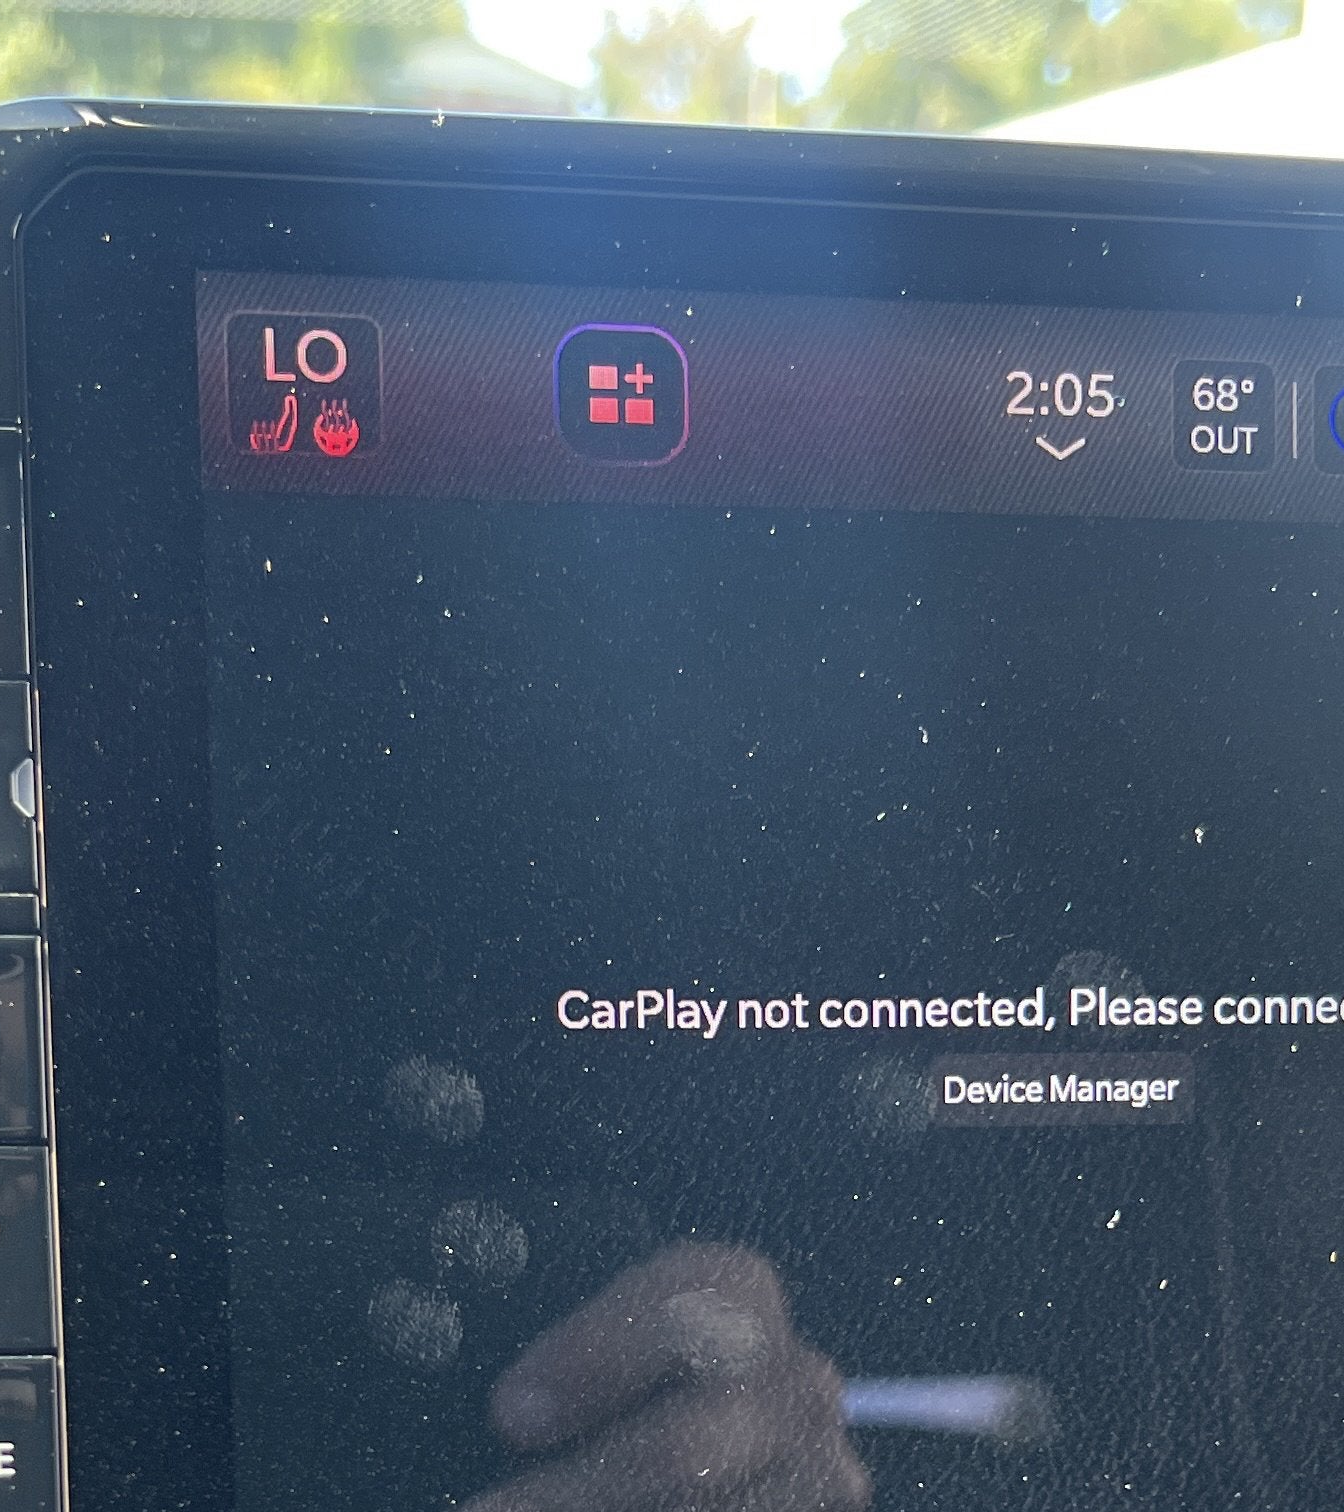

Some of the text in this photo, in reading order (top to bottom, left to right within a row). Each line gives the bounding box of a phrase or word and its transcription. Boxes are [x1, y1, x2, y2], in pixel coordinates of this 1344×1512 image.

[262, 327, 348, 384] LO
[1006, 370, 1115, 418] 2:05
[1193, 374, 1255, 413] 68°
[1189, 425, 1257, 456] OUT
[556, 990, 725, 1038] CarPlay
[736, 994, 809, 1031] not
[818, 993, 1058, 1032] connected,
[1067, 988, 1203, 1028] Please
[943, 1073, 1181, 1110] Device Manager
